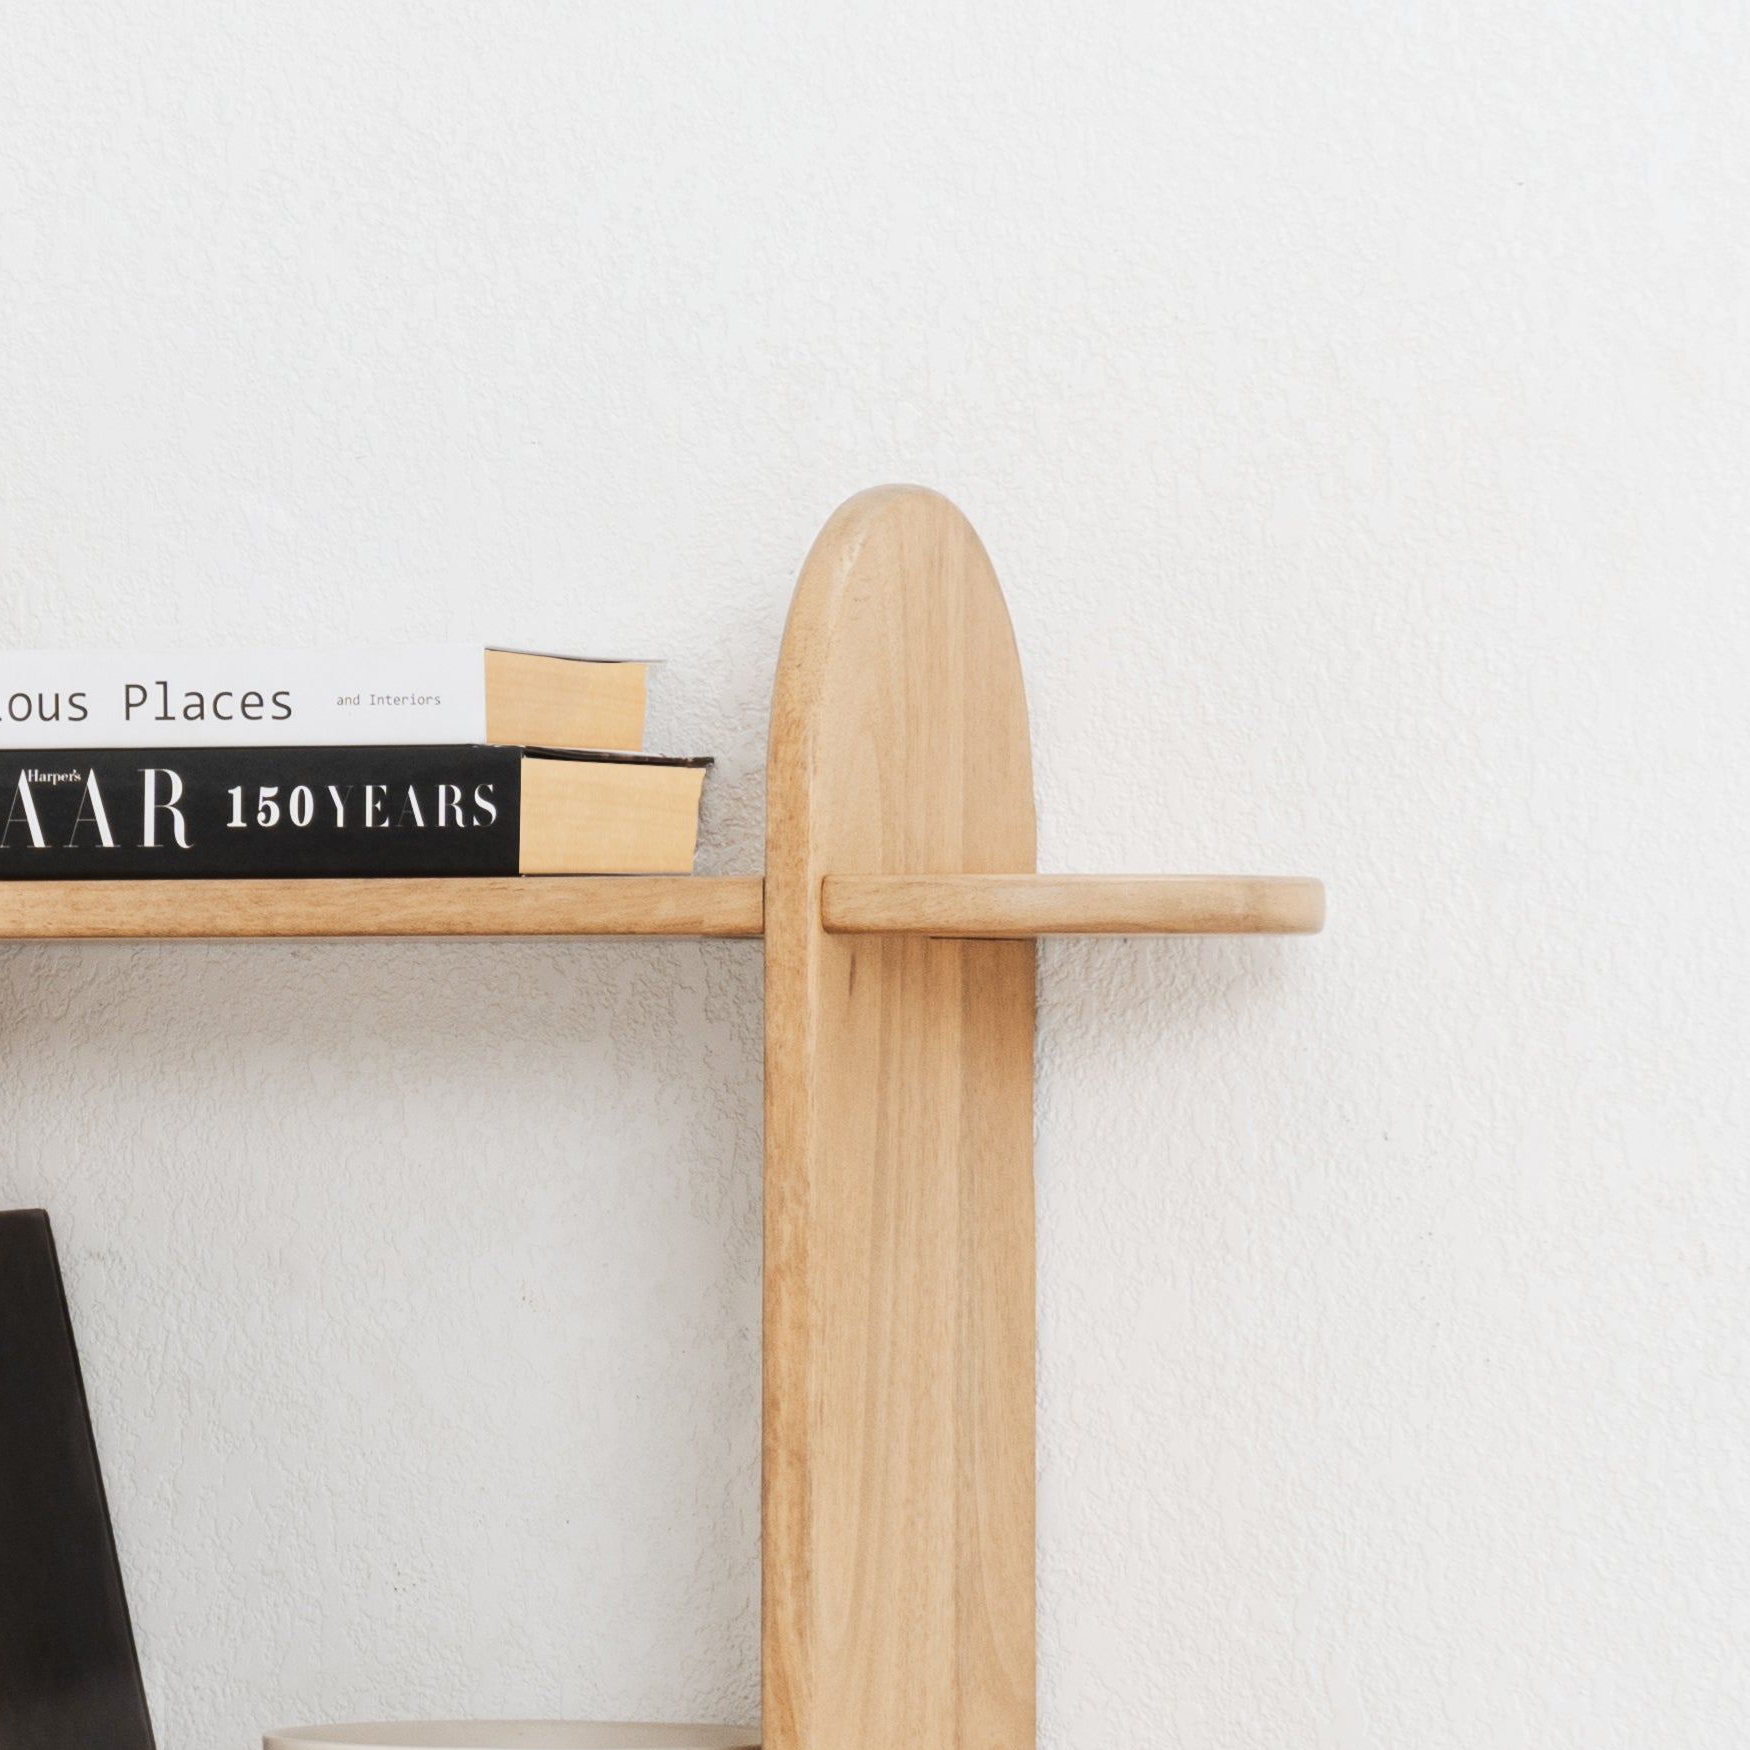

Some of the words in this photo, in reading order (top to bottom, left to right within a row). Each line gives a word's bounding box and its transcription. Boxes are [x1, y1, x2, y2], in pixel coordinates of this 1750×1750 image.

[123, 681, 293, 722] Places
[336, 693, 361, 706] and
[369, 693, 442, 707] Interiors
[27, 768, 82, 786] Harper's
[226, 784, 315, 829] 150
[324, 784, 498, 829] YEARS
